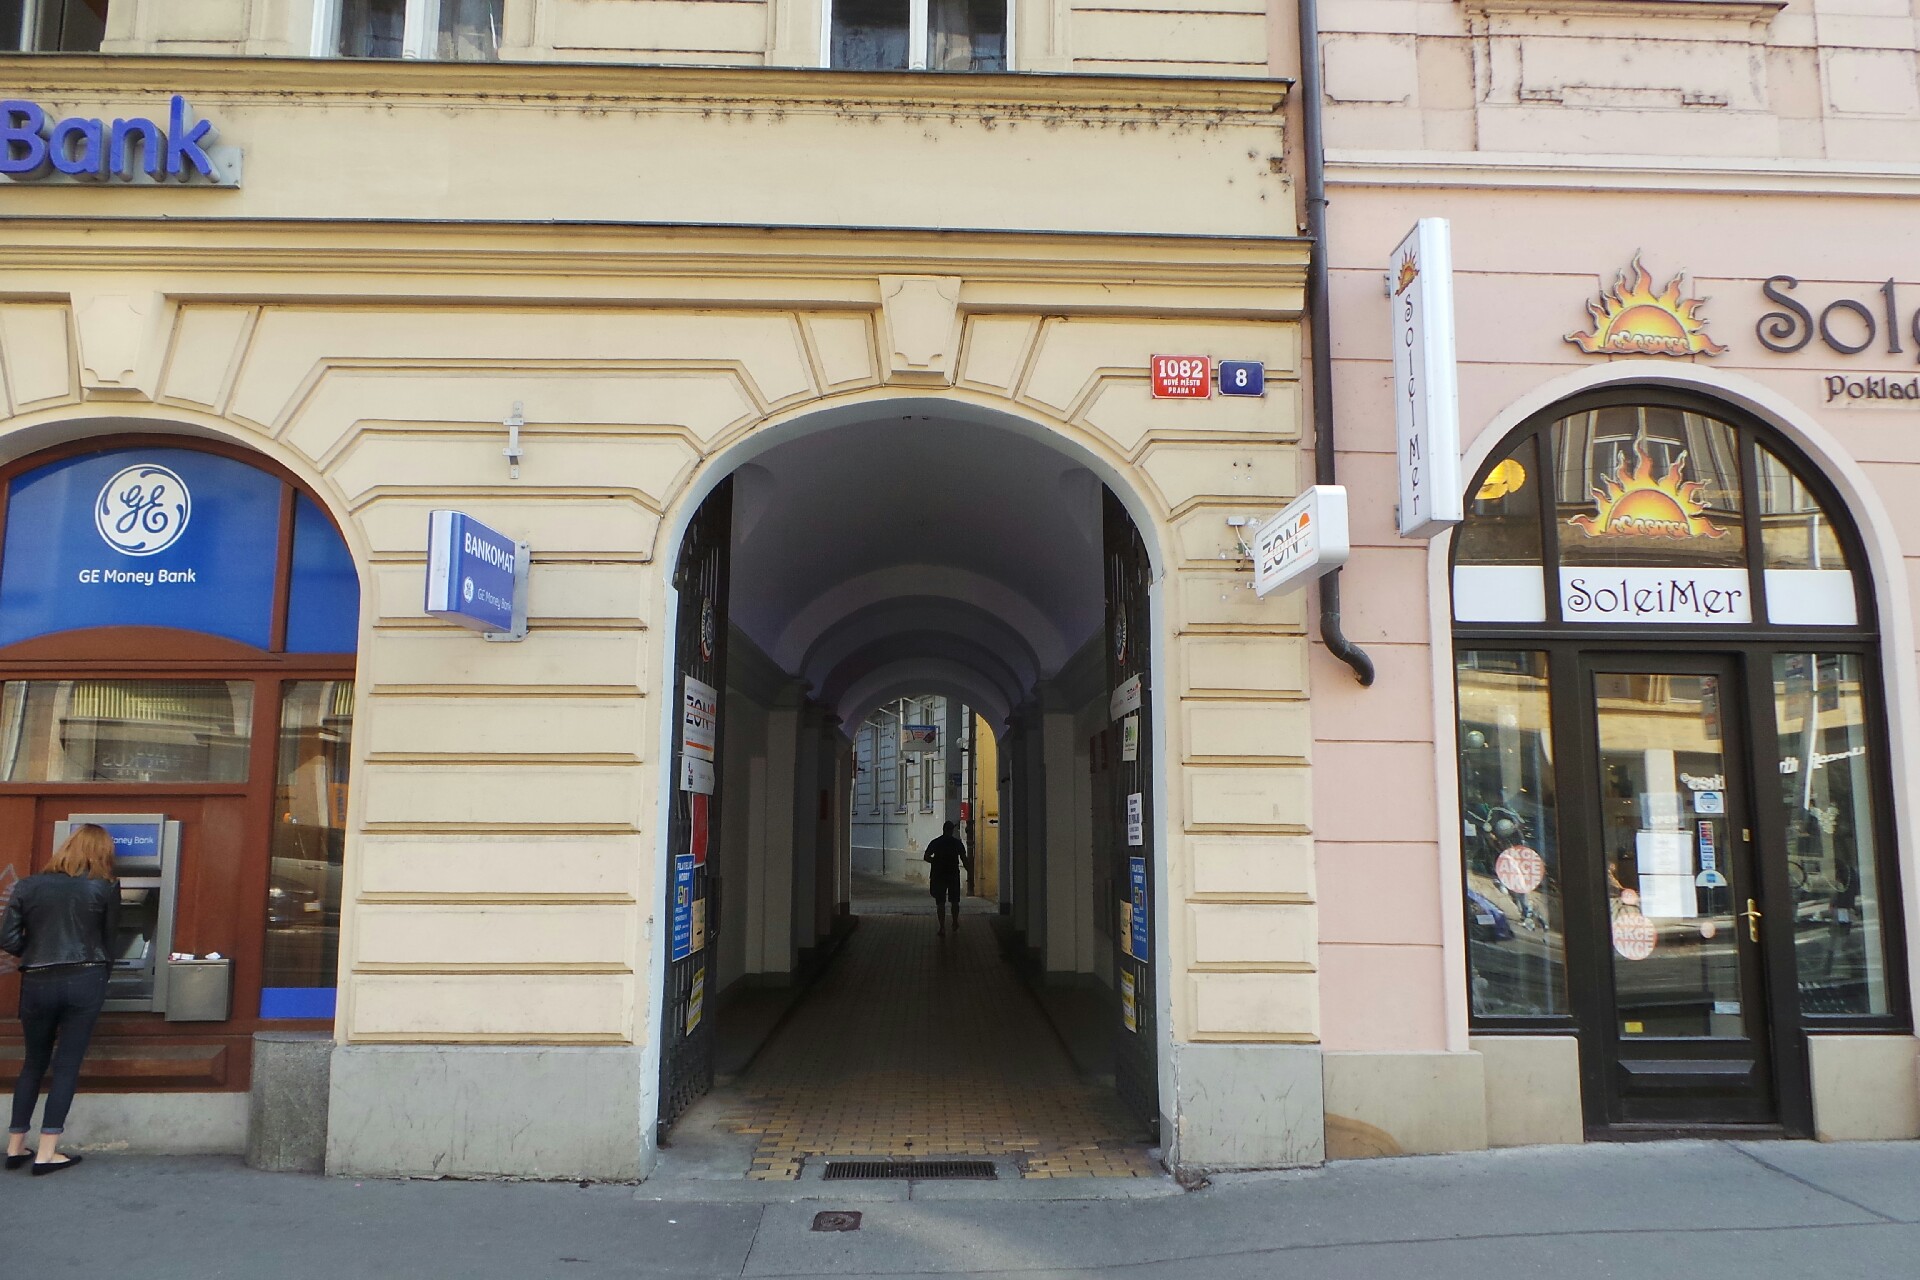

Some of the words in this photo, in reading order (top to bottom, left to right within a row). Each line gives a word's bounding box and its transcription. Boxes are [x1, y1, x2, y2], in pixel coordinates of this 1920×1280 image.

[0, 94, 216, 178] Bank
[1756, 274, 1920, 365] Sol
[1159, 359, 1203, 378] 1082
[1235, 368, 1248, 387] 8
[1163, 378, 1178, 386] NOVÉ
[1180, 378, 1200, 386] MĚSTO
[1825, 374, 1920, 402] Poklad
[465, 532, 514, 574] BANKOMAT
[78, 569, 100, 583] GE
[104, 569, 154, 586] Money
[158, 568, 196, 583] Bank
[477, 588, 486, 601] GE
[485, 591, 501, 610] Money
[501, 598, 512, 612] Bank
[1567, 578, 1742, 617] SoleiMer
[112, 837, 133, 846] oney
[134, 836, 154, 844] Bank
[1500, 859, 1541, 874] AKCE
[1614, 927, 1654, 940] AKCE
